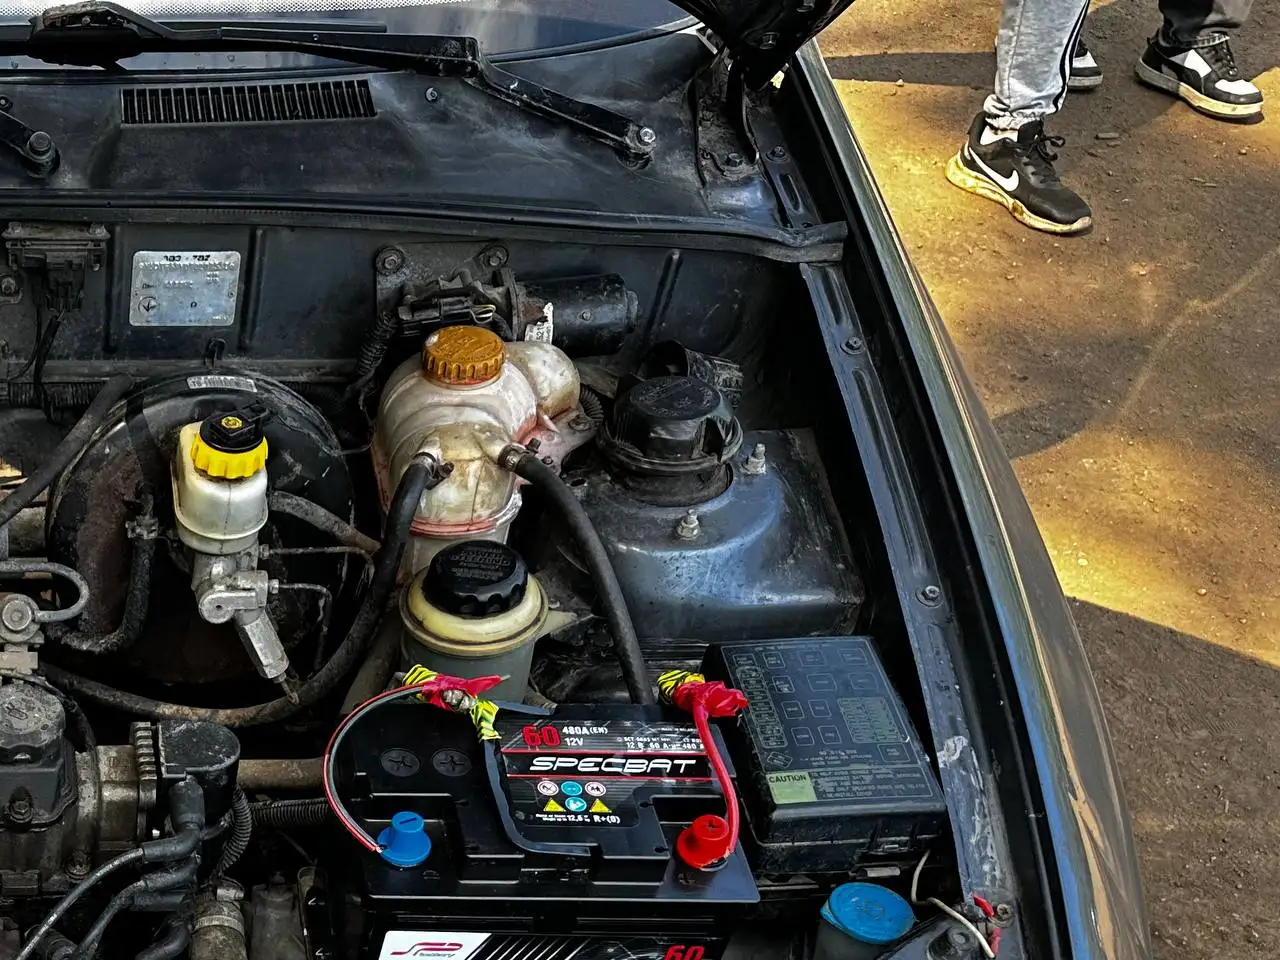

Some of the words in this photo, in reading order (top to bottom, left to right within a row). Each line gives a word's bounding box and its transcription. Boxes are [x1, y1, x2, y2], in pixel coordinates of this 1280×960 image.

[522, 723, 561, 747] 60
[565, 738, 584, 747] 12V
[529, 756, 697, 774] SPECBAT
[769, 774, 807, 784] CAUTION
